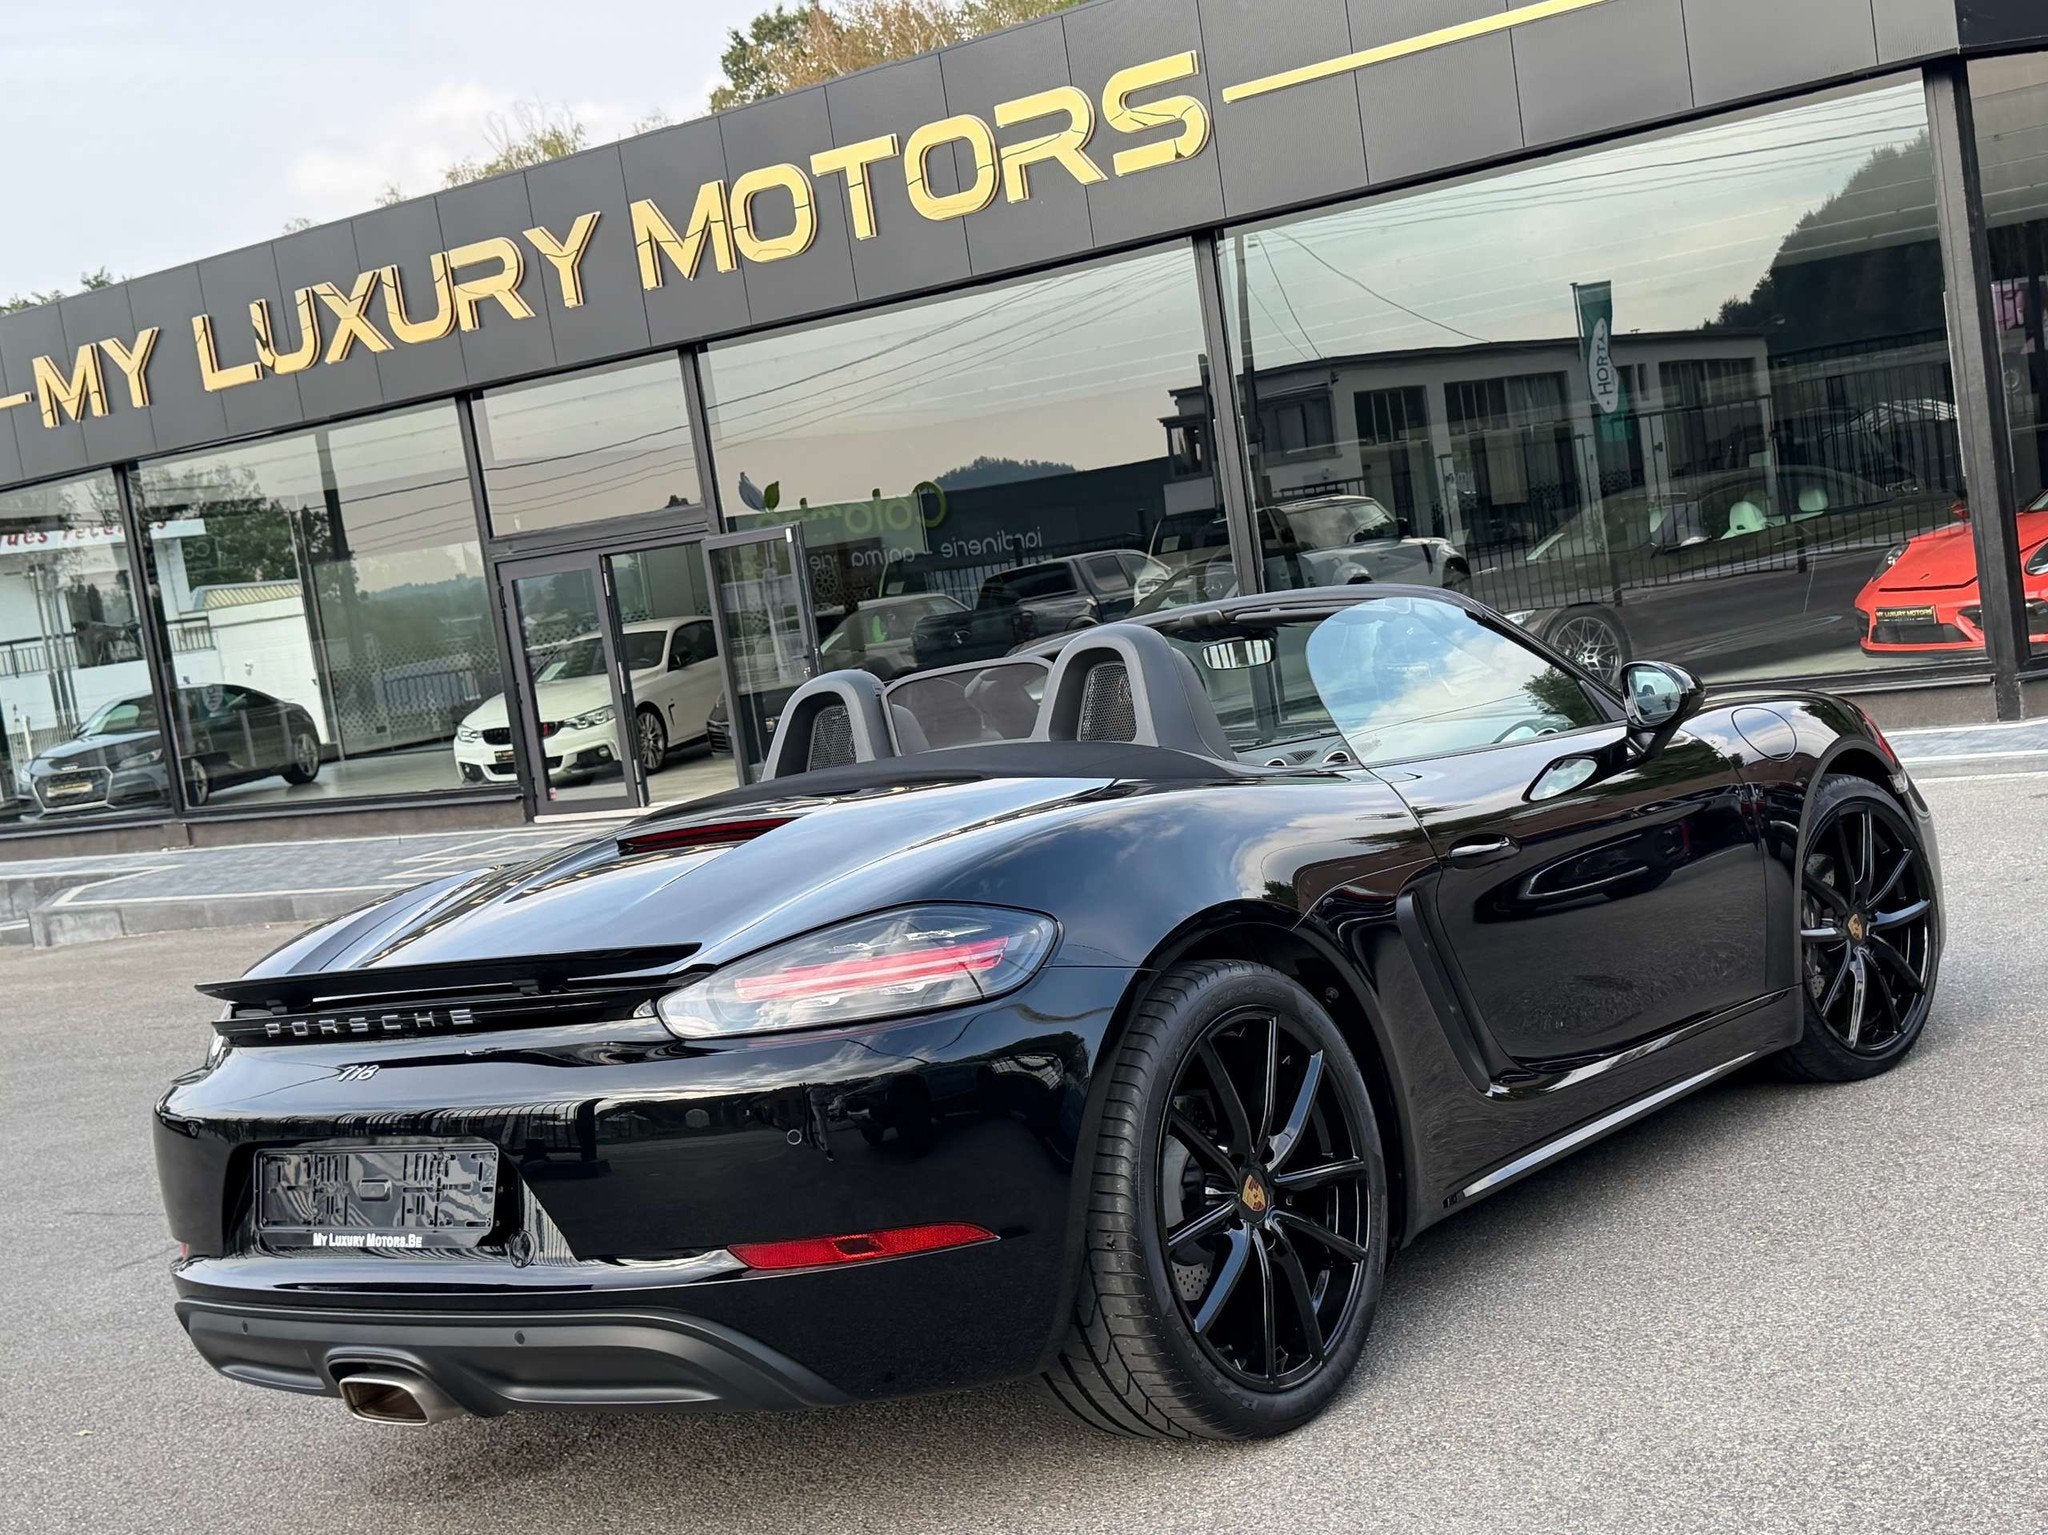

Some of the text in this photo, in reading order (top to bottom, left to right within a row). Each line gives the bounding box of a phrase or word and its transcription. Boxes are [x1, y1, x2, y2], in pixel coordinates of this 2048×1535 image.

[32, 50, 1211, 428] MY LUXURY MOTORS
[265, 1008, 474, 1038] PORSCHE
[338, 1064, 380, 1082] 718
